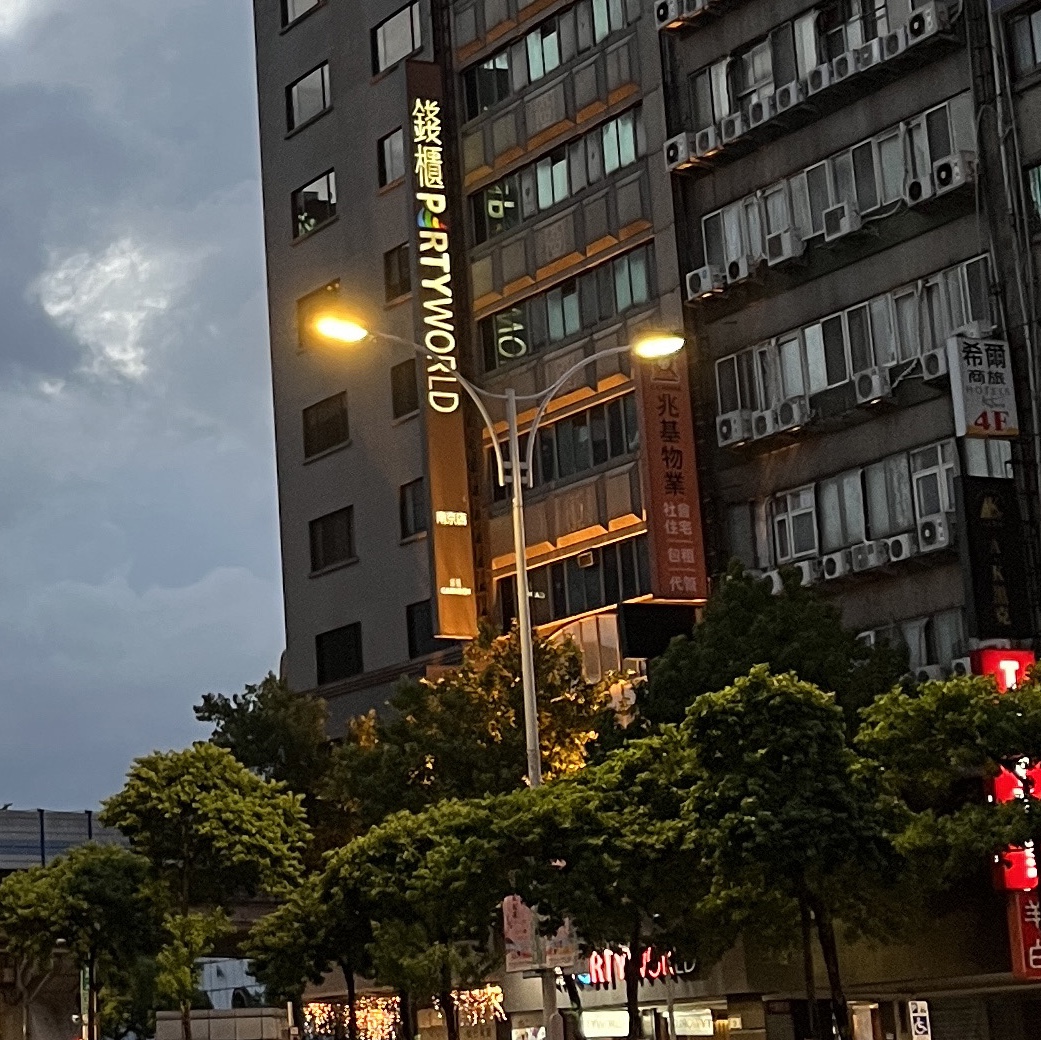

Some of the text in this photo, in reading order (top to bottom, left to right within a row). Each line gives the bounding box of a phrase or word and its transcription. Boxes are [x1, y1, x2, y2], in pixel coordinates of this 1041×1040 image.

[412, 98, 445, 189] 錢櫃
[962, 341, 1006, 369] 希爾
[974, 410, 1010, 432] 4F
[657, 393, 685, 496] 兆基物業
[665, 519, 693, 536] 住宅
[667, 547, 695, 564] 包租
